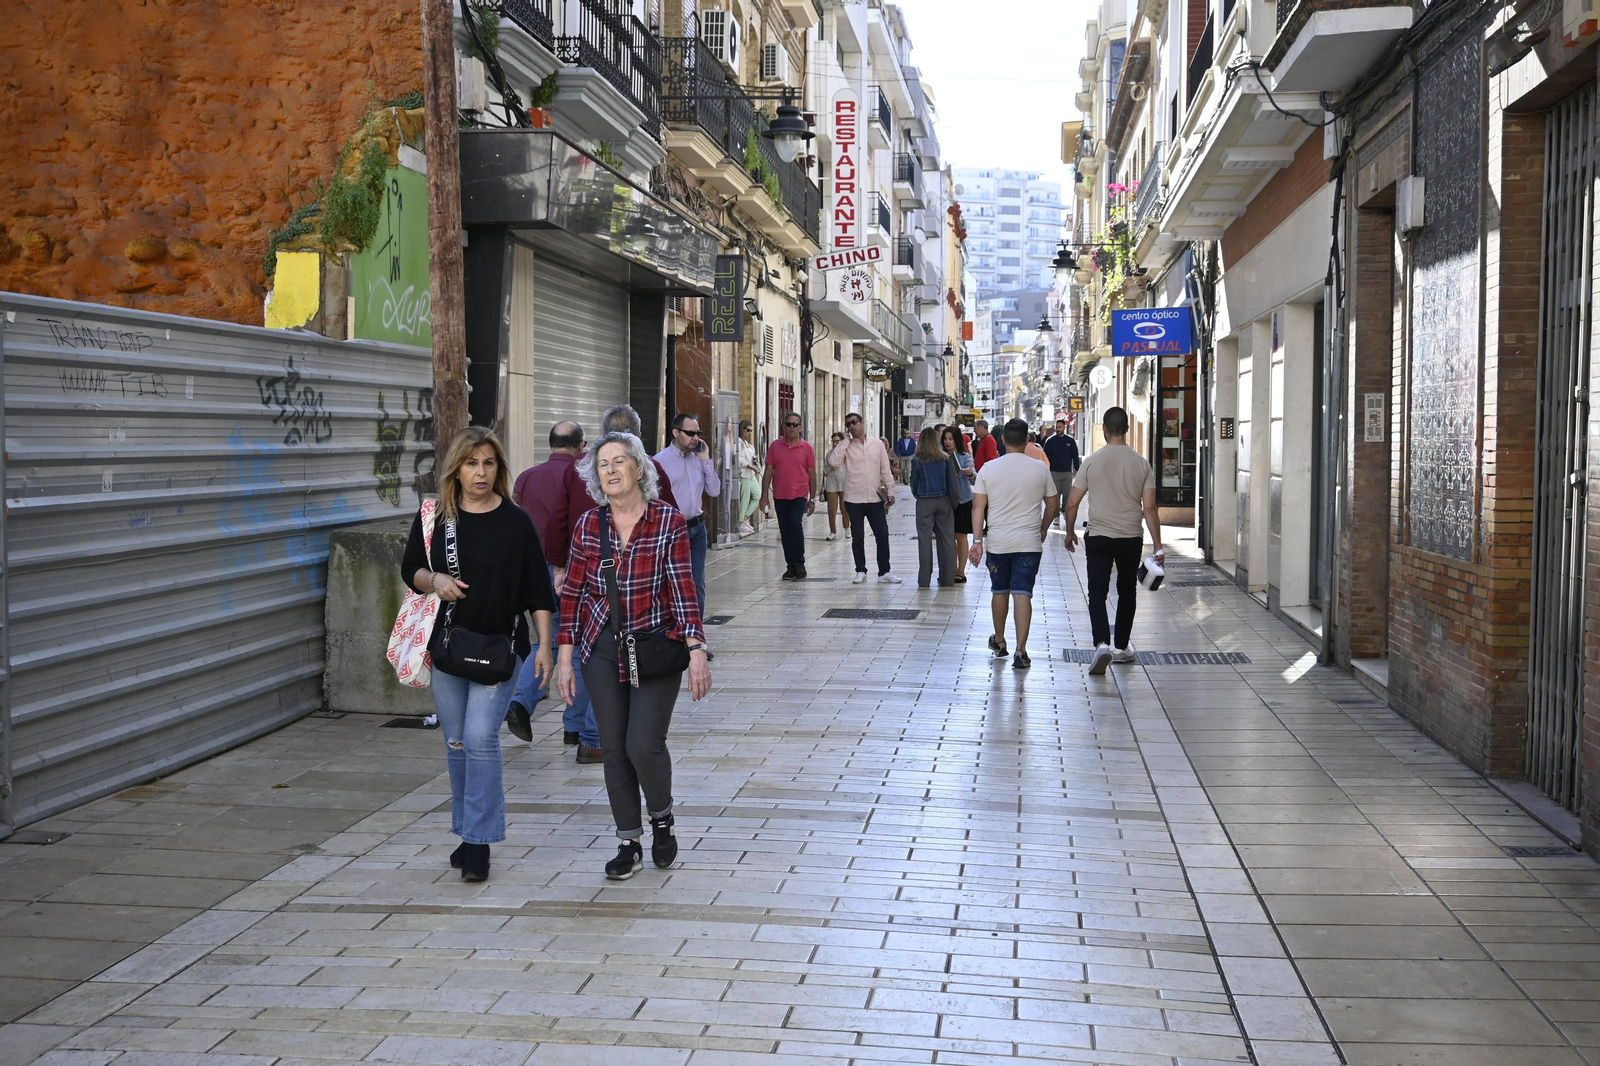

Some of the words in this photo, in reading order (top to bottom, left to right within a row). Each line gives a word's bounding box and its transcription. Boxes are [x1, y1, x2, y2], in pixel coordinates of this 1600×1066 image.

[834, 100, 856, 248] RESTAURANTE
[816, 247, 880, 269] CHINO
[1121, 311, 1150, 321] centro
[1151, 310, 1180, 321] óptico
[447, 542, 458, 569] LOLA
